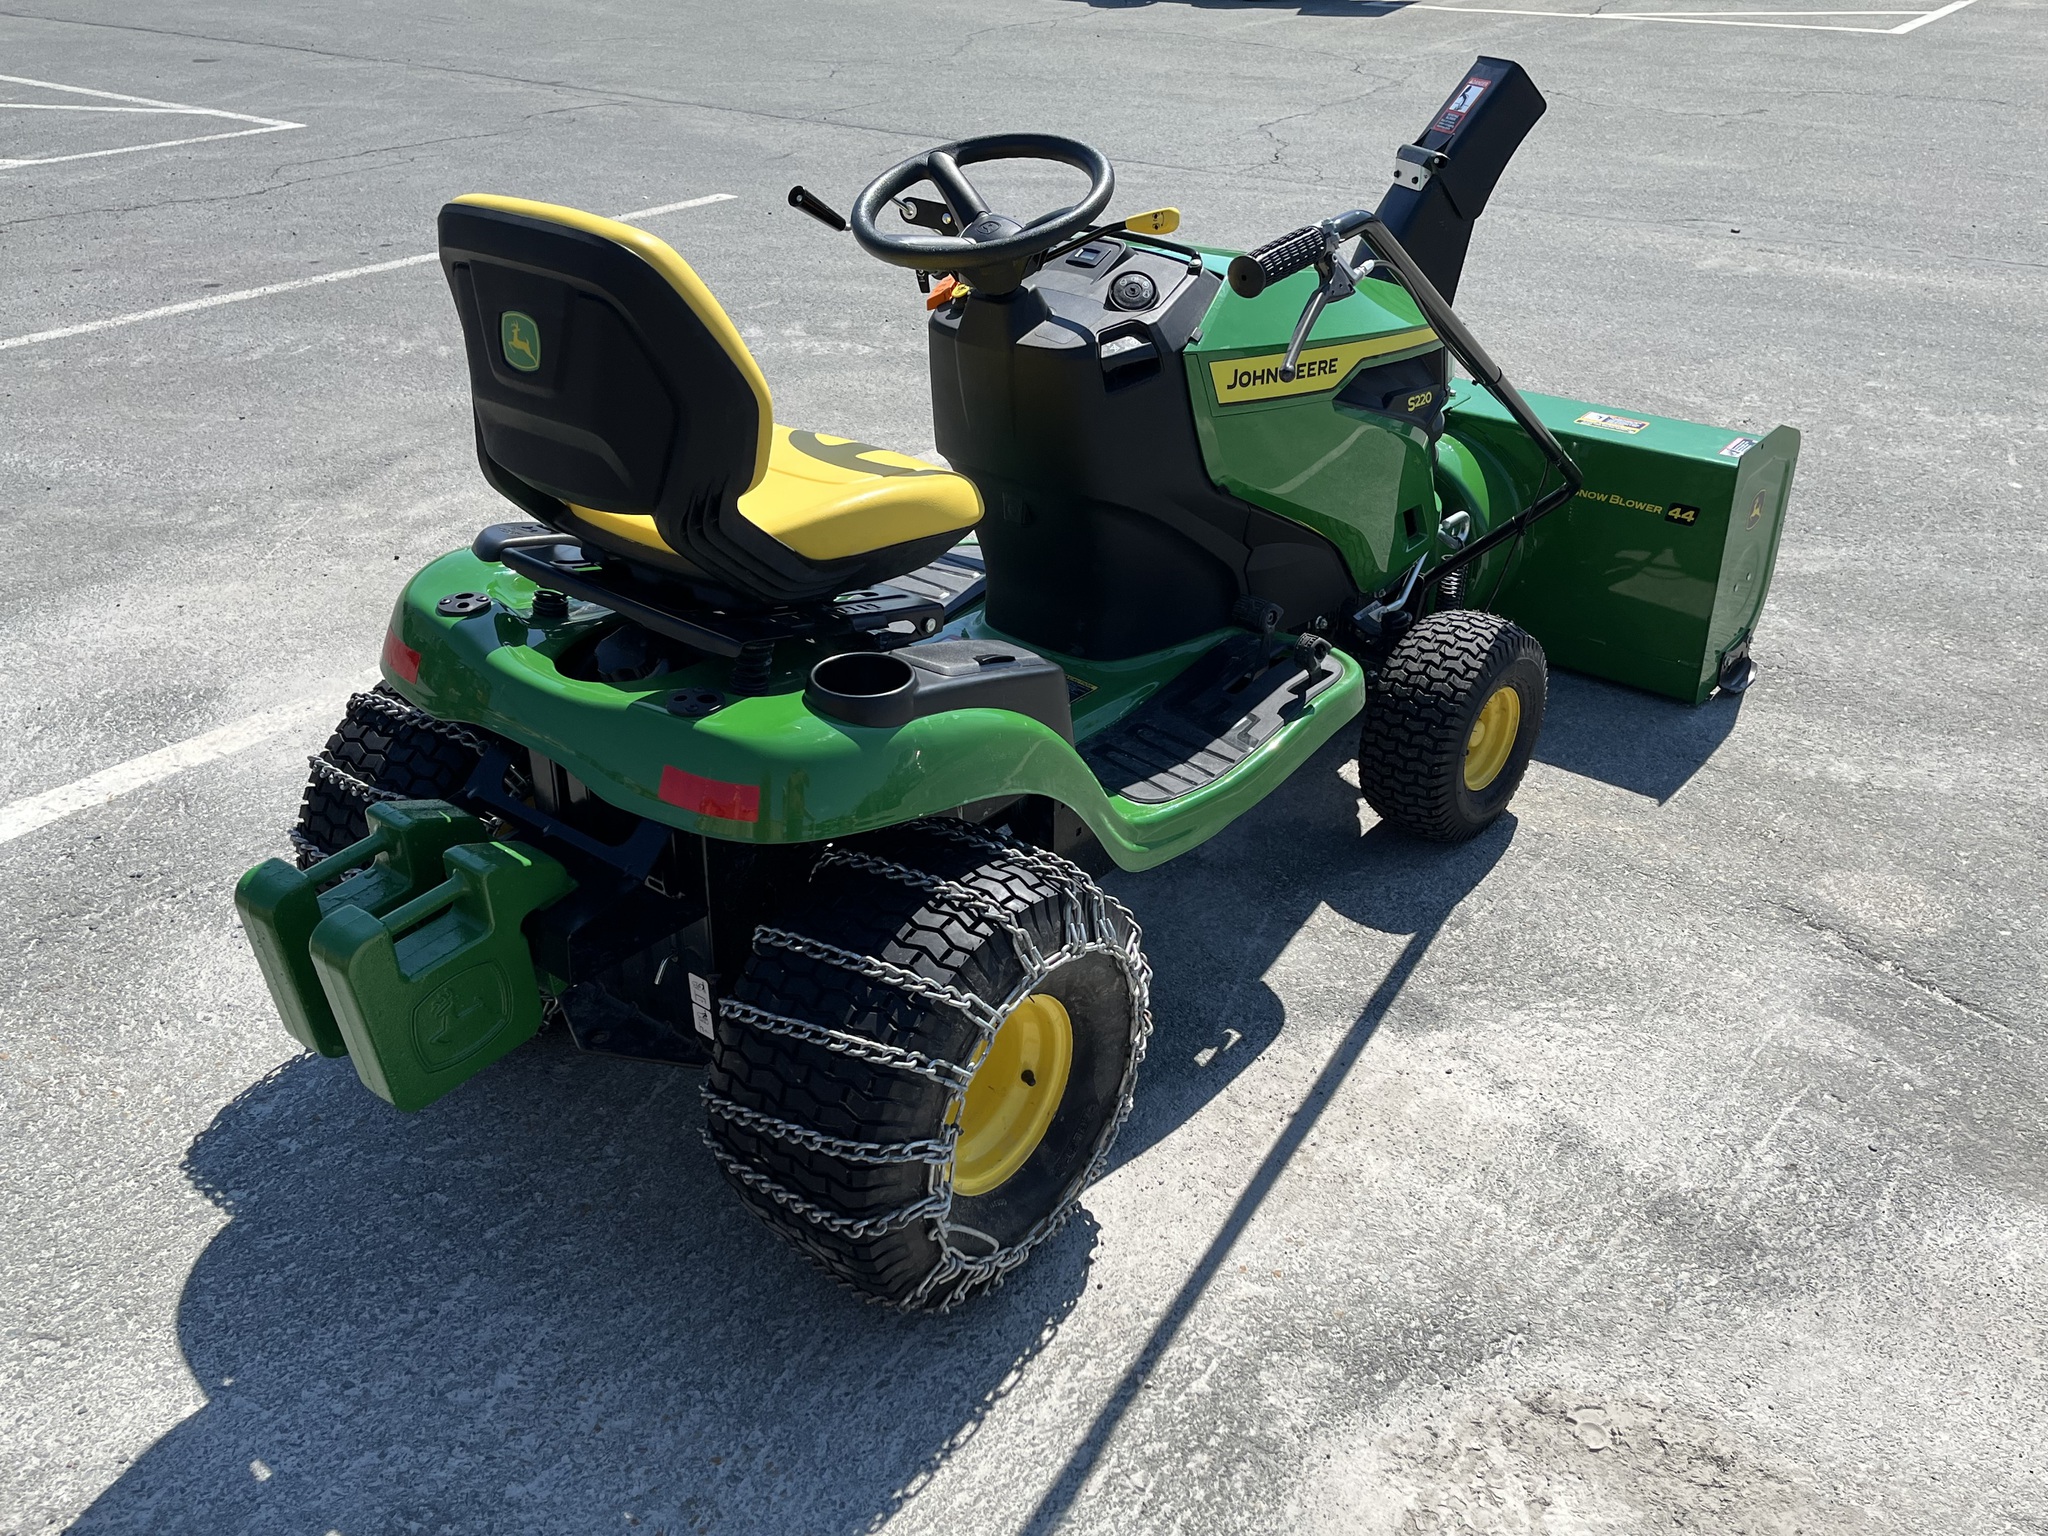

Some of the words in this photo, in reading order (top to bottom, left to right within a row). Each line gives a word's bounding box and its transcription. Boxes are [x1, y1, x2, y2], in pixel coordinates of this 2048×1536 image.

[1227, 367, 1280, 390] JOHN
[1290, 358, 1338, 381] EERE
[1407, 391, 1432, 412] S220
[1576, 489, 1608, 502] NOW
[1609, 494, 1663, 514] BLOWER
[1668, 507, 1695, 522] 44
